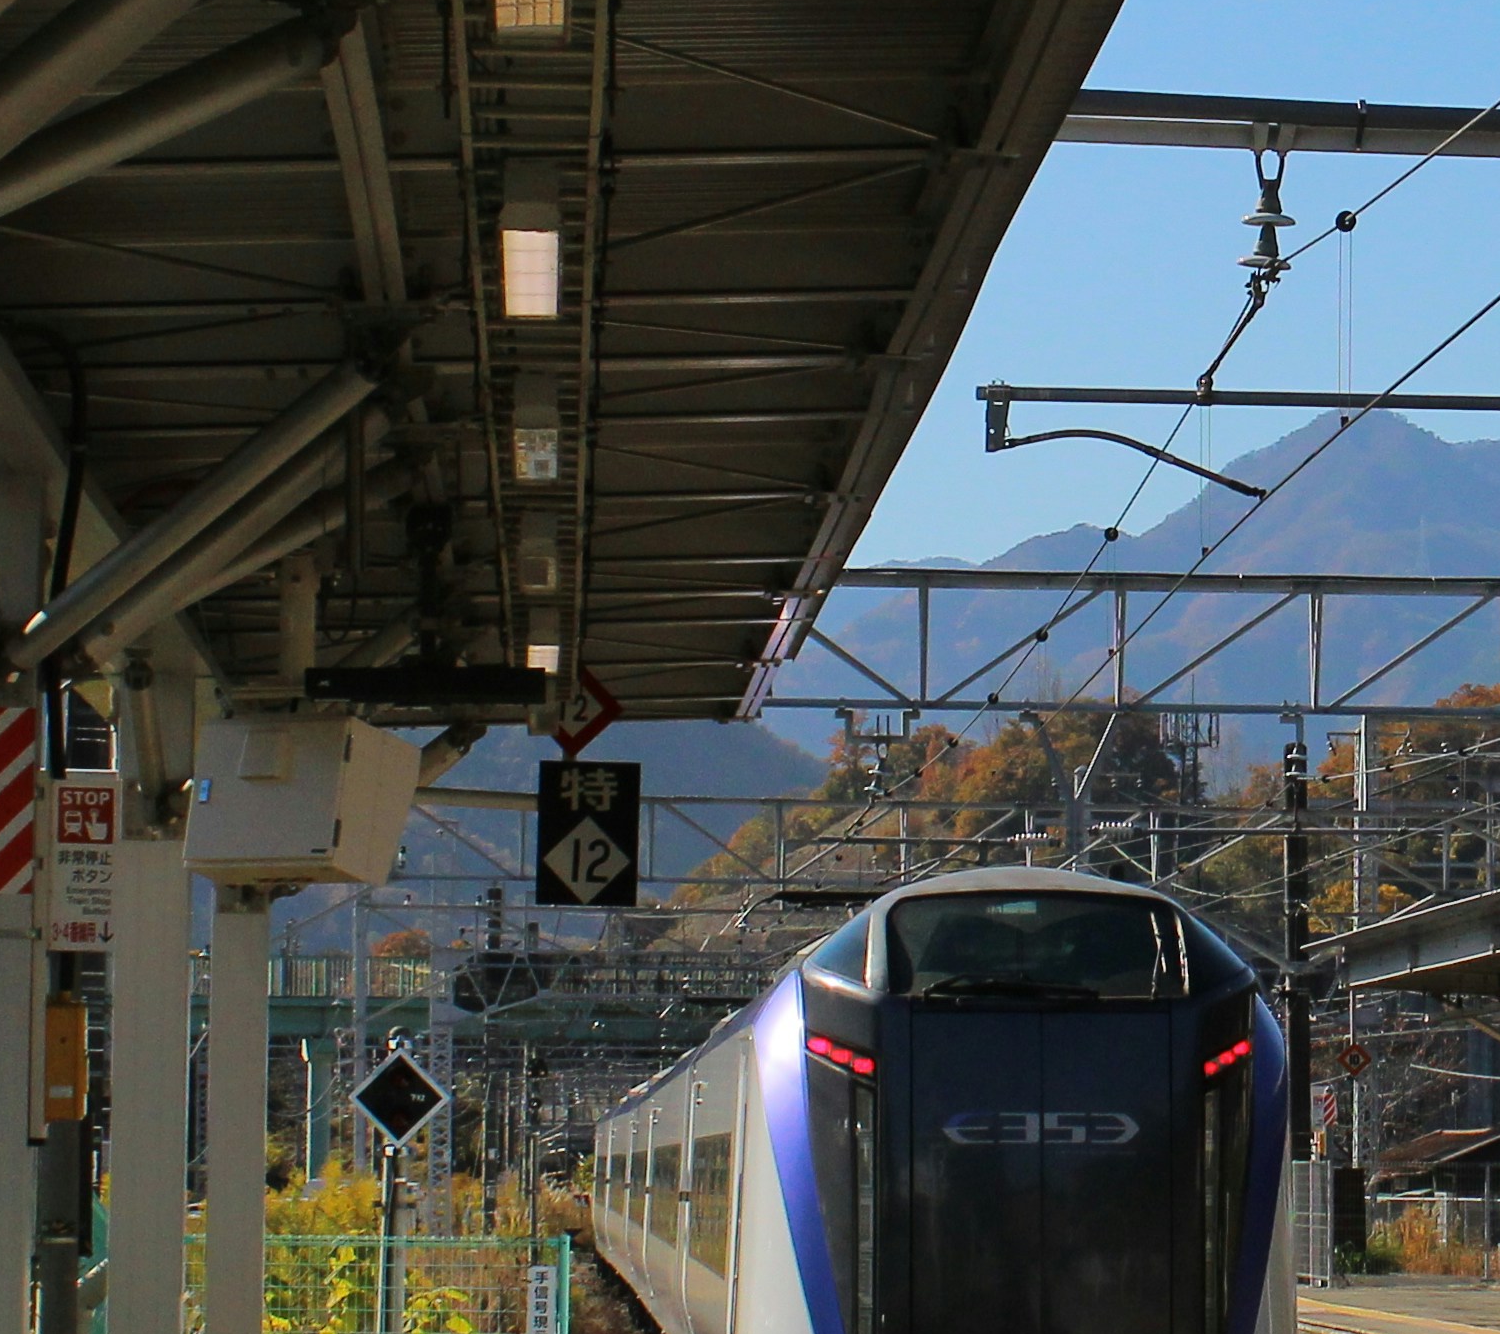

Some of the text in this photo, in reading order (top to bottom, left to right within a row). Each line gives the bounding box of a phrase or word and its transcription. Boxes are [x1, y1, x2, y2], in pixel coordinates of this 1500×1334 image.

[62, 791, 110, 805] STOP
[559, 768, 619, 812] 特
[57, 850, 112, 865] 非常停止
[568, 838, 611, 884] 12
[72, 868, 112, 883] ボタン
[942, 1111, 1140, 1145] E353
